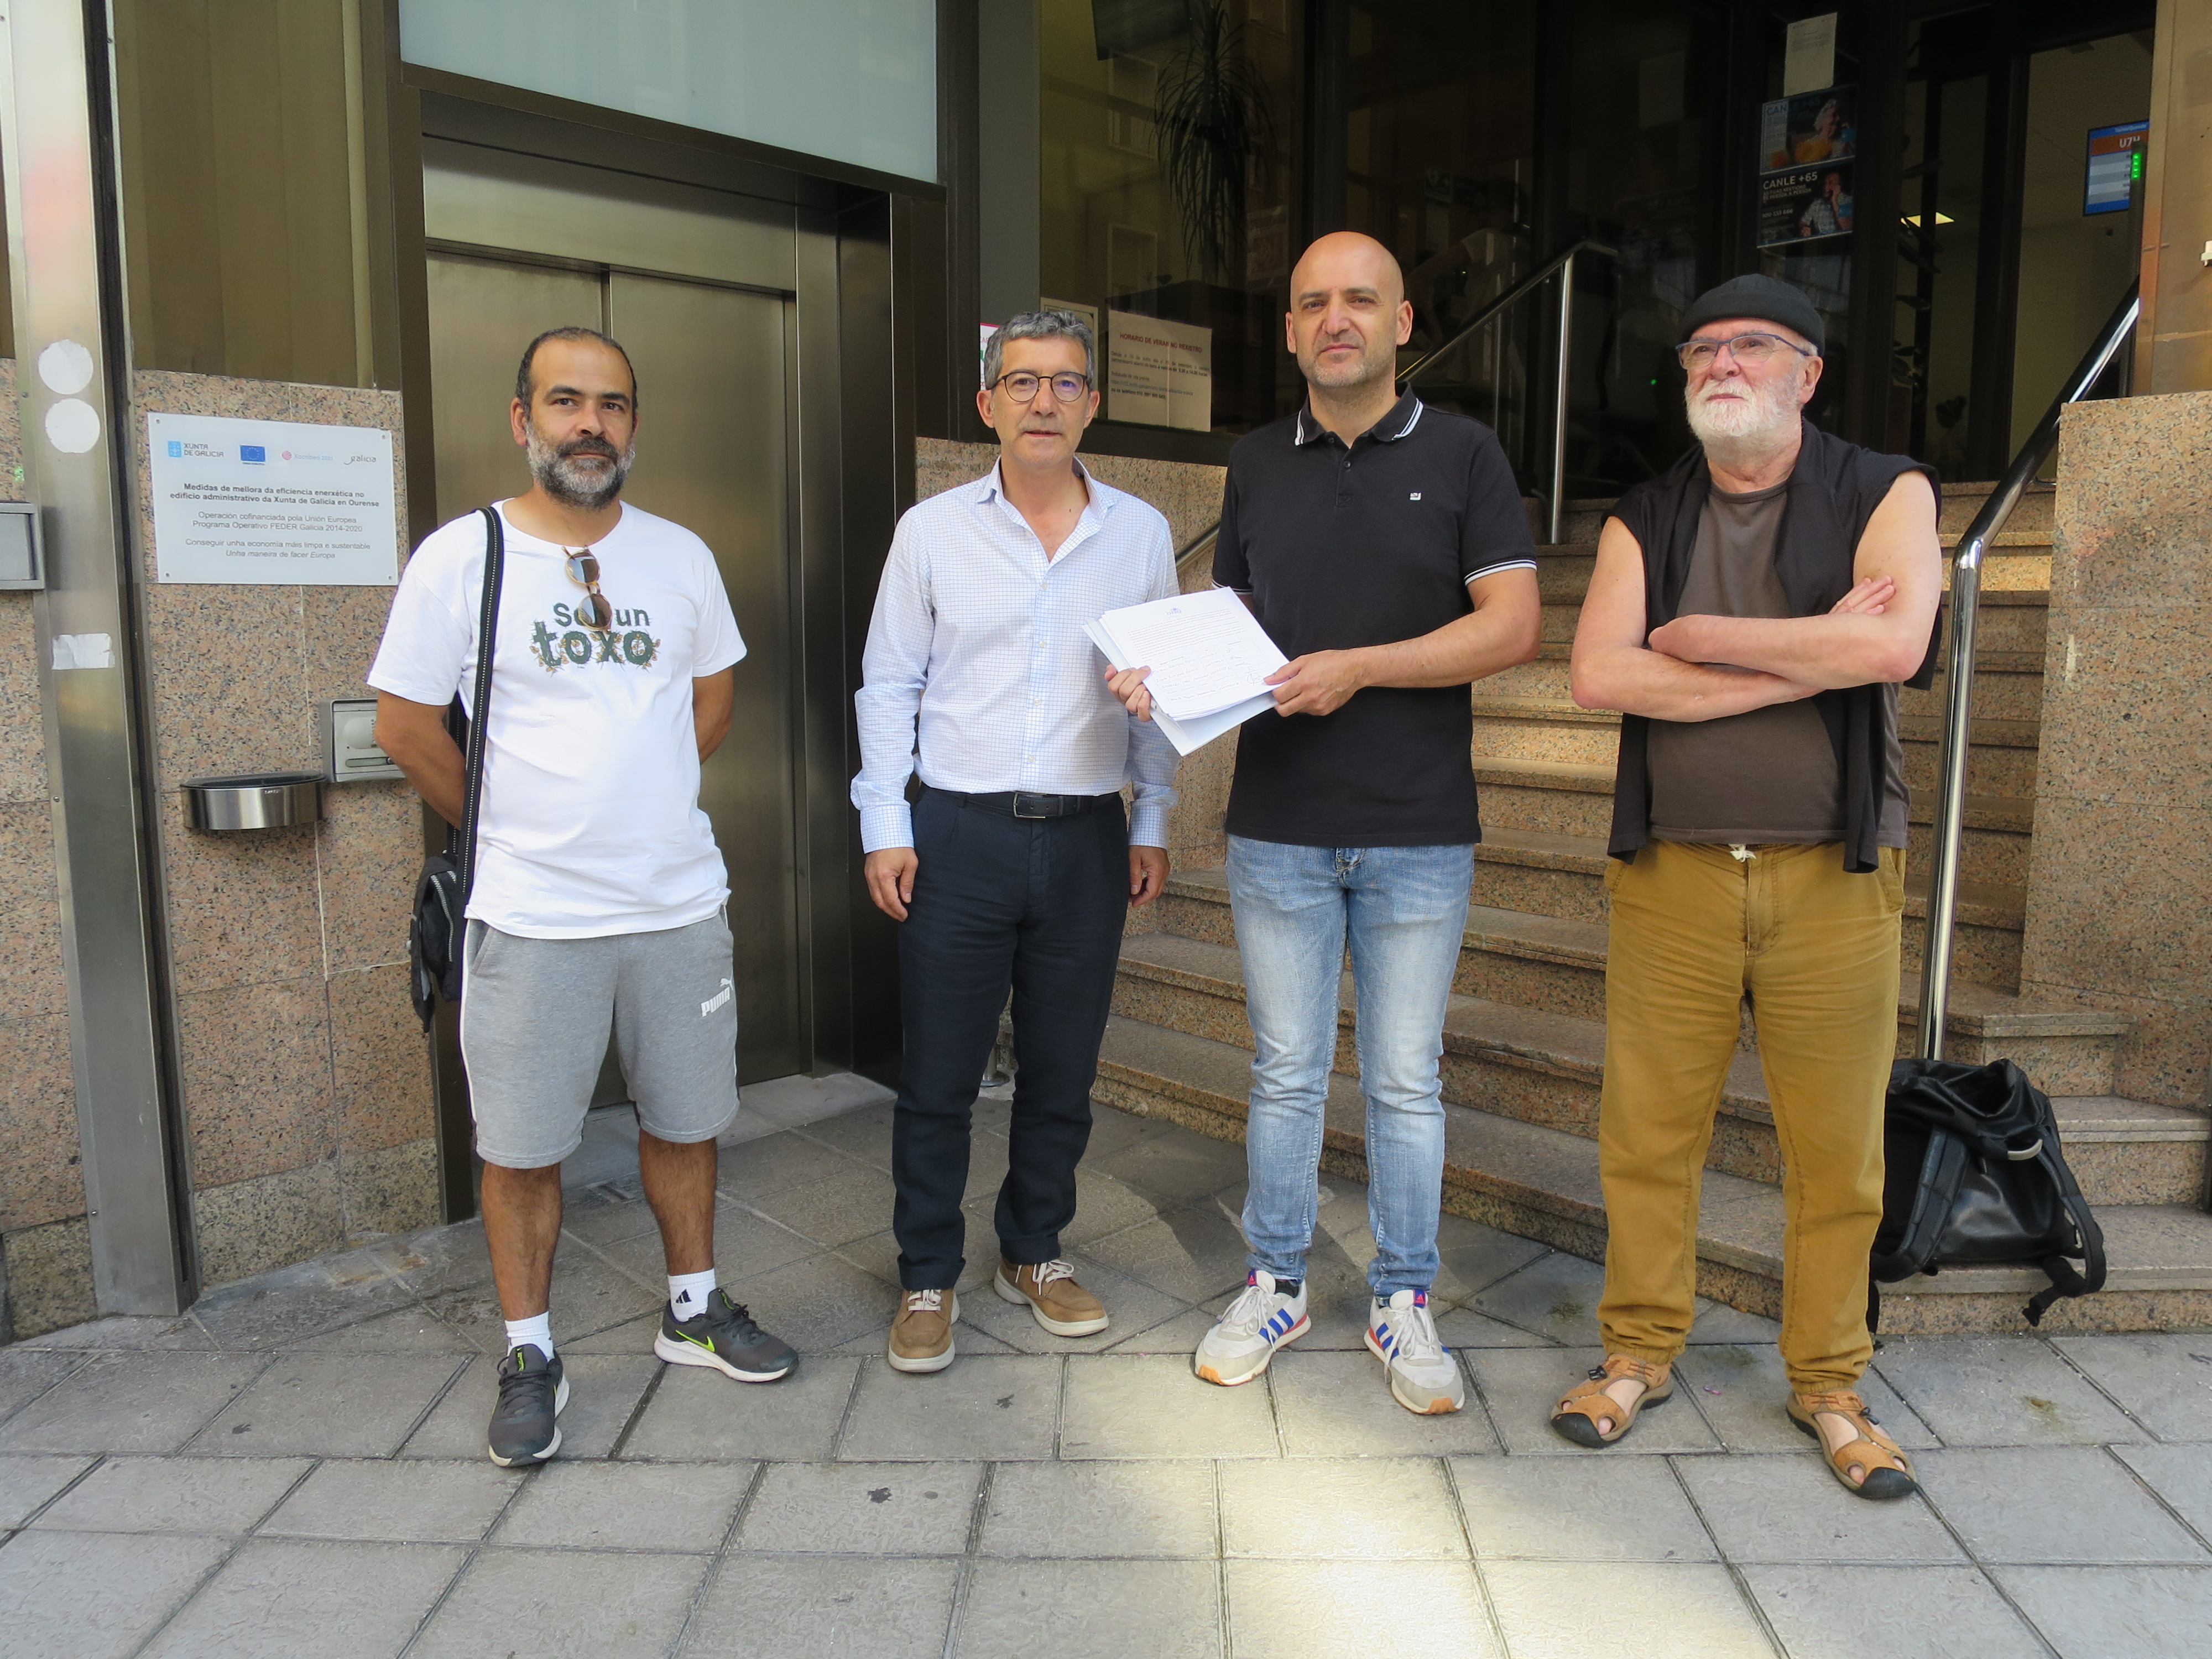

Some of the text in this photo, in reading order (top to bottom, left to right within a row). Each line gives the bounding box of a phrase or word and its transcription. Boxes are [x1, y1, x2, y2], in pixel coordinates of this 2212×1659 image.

[1764, 171, 1818, 190] CANLE +65
[1120, 333, 1143, 342] HORARIO
[1178, 343, 1202, 353] REXISTRO
[343, 455, 377, 466] galicia
[184, 483, 218, 491] Medidas
[315, 489, 353, 497] enerxética
[202, 493, 260, 502] administrativo
[310, 497, 335, 505] Galicia
[198, 510, 237, 520] Operación
[239, 513, 285, 521] cofinanciada
[327, 516, 357, 524] Europea
[192, 520, 230, 529] Programa
[232, 521, 268, 530] Operativo
[185, 538, 223, 547] Conseguir
[305, 541, 322, 550] limpa
[615, 607, 650, 627] un
[531, 620, 655, 667] toxo
